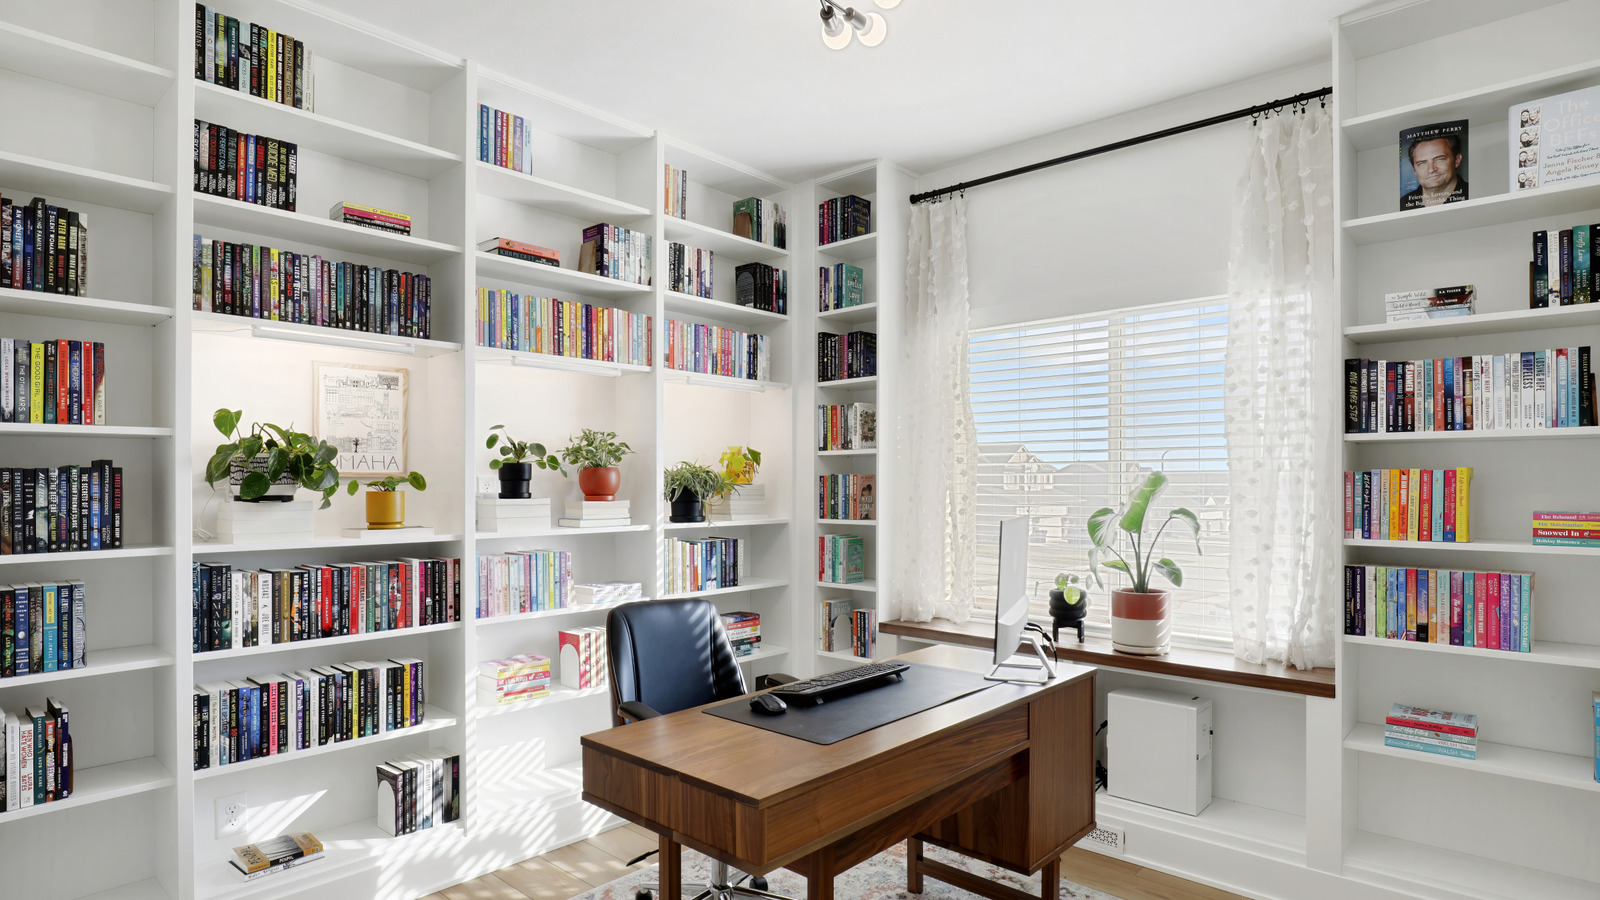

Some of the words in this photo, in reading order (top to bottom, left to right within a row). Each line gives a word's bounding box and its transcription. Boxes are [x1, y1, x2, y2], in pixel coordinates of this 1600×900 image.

[1556, 99, 1589, 114] The
[1407, 130, 1440, 139] MATTHEW
[1551, 127, 1596, 146] BFFs
[1567, 156, 1593, 164] Fischer
[267, 167, 277, 182] MED
[1546, 168, 1572, 176] Angela
[1574, 163, 1599, 171] Kinsey
[1576, 232, 1585, 247] Firefly
[1536, 357, 1545, 376] LOSING
[1349, 372, 1358, 384] ONE
[1405, 364, 1413, 392] SLAMMED
[1523, 359, 1533, 390] HOPELESS
[1536, 378, 1545, 392] HOPE
[1349, 386, 1358, 404] MORE
[1349, 405, 1358, 422] STEP
[335, 455, 399, 471] MAHA
[212, 603, 221, 635] MARY
